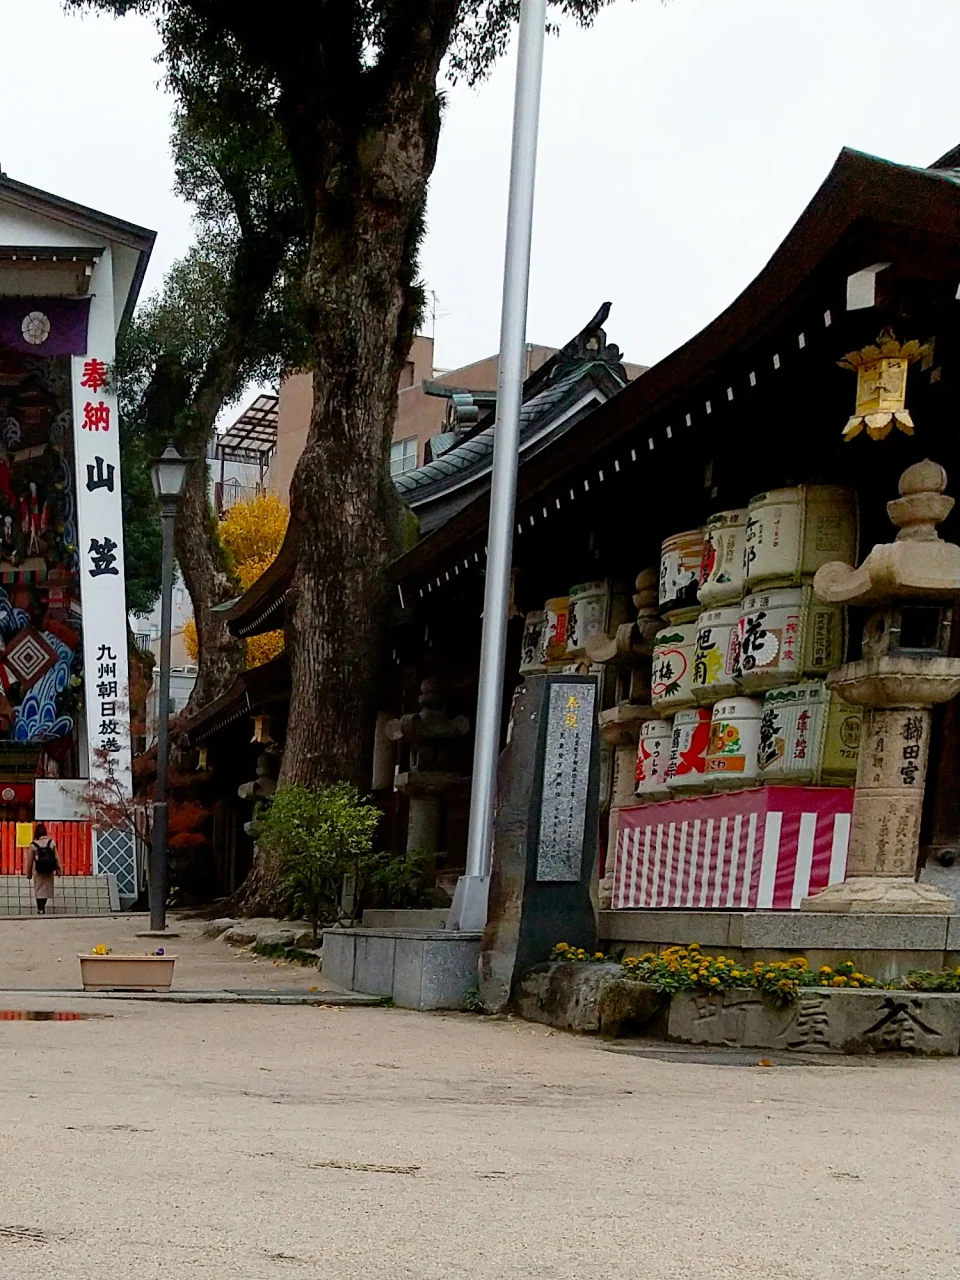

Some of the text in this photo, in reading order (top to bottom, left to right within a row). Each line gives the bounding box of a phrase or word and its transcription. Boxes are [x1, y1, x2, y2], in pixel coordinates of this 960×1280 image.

[79, 357, 112, 433] 奉納
[85, 455, 121, 579] 山笠
[94, 642, 123, 754] 九州朝日放送
